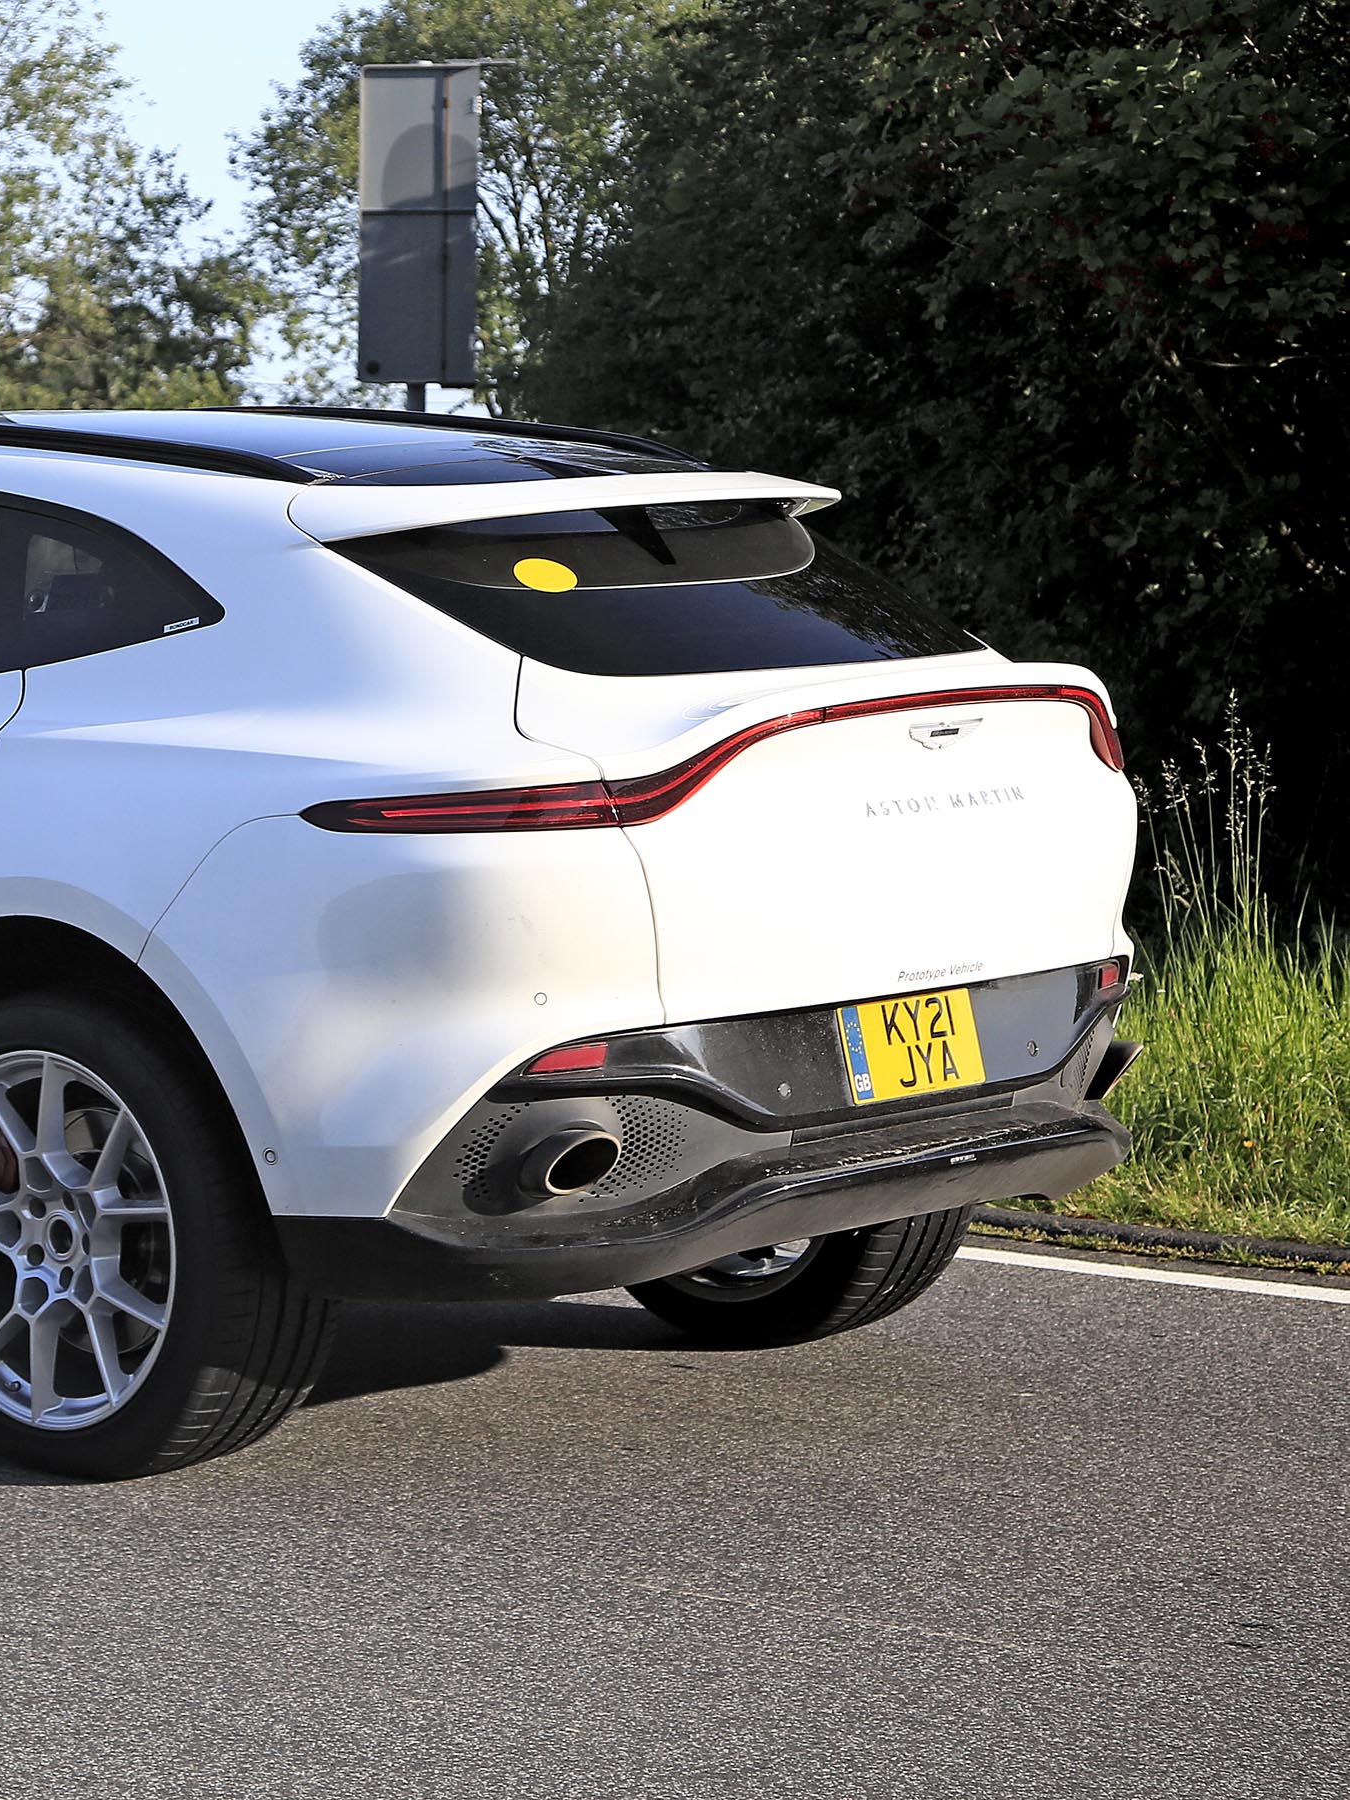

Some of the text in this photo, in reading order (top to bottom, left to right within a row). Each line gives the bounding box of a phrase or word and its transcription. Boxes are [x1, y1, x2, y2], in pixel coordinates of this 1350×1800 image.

[866, 785, 1025, 818] ASTON MARTIN
[897, 961, 984, 983] Prototype Vehicle
[881, 995, 955, 1046] KY21
[900, 1040, 960, 1087] JYA
[855, 1073, 872, 1093] GB
